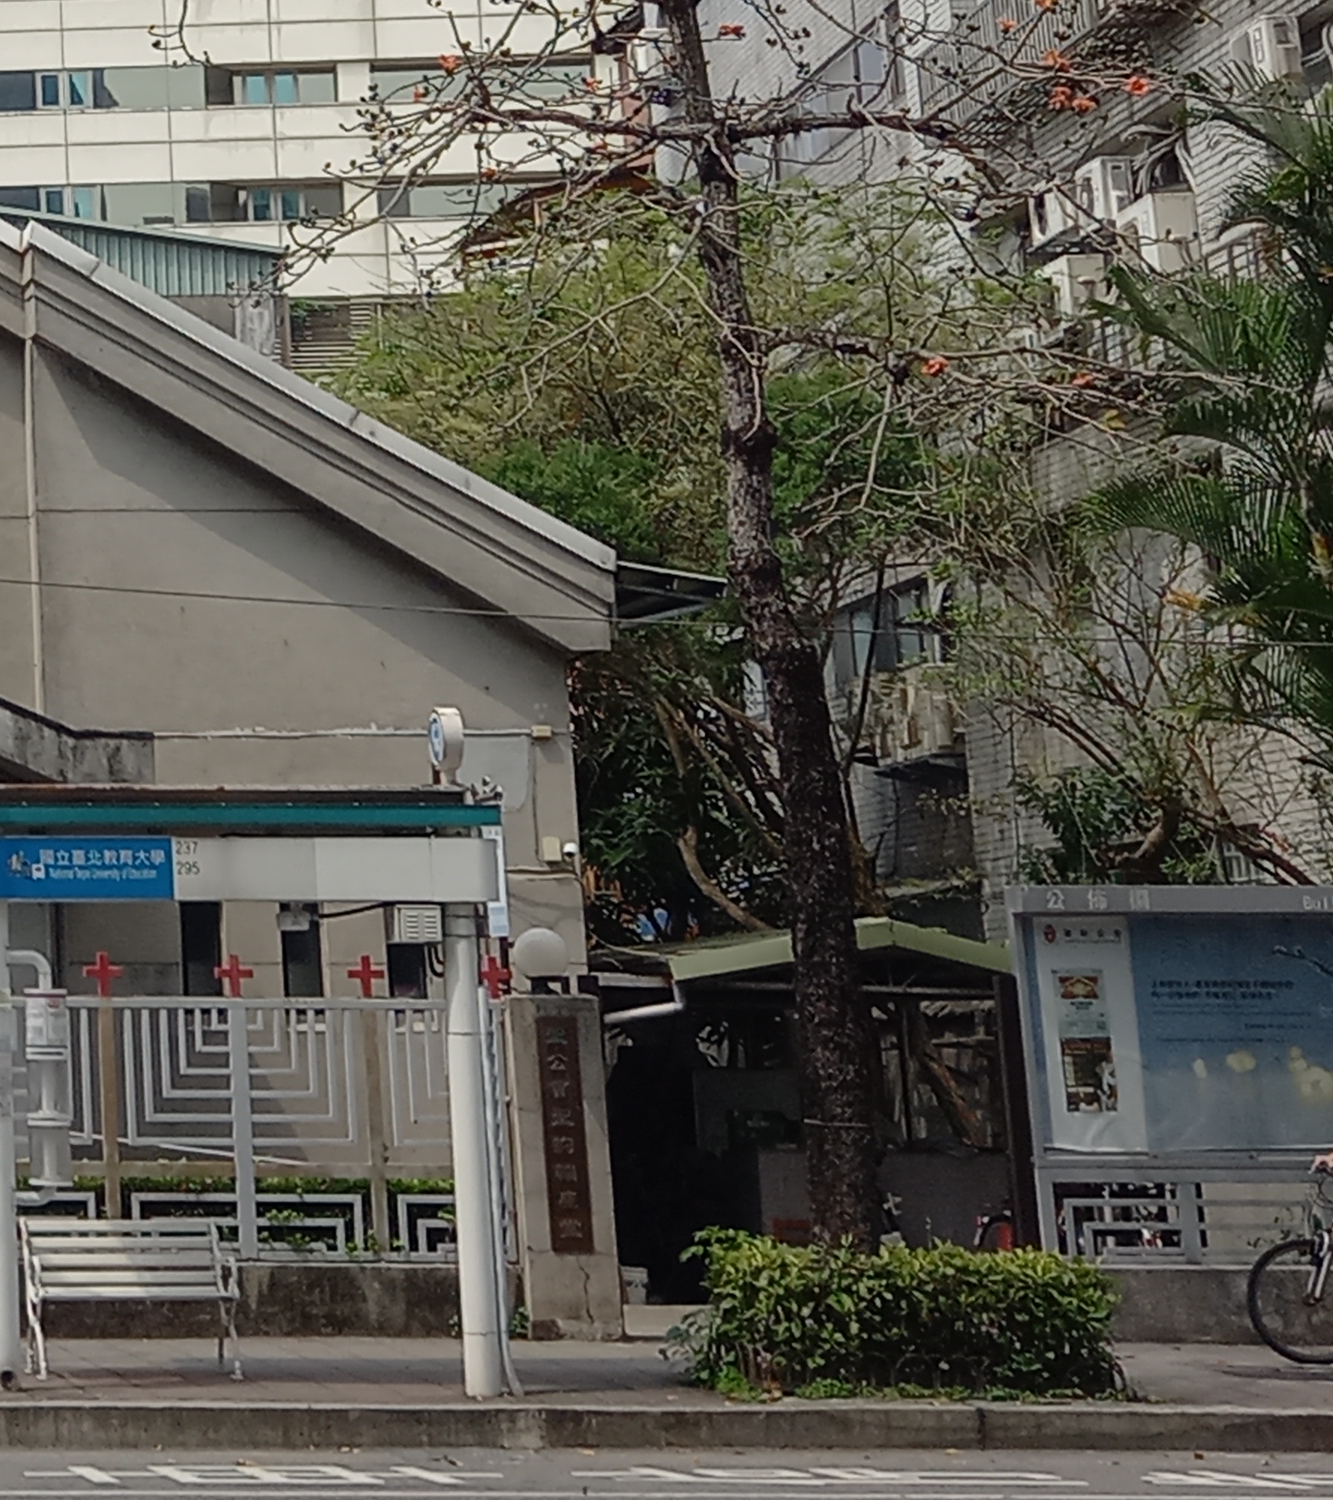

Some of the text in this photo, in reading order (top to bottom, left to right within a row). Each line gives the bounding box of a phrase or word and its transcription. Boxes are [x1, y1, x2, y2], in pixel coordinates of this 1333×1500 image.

[175, 841, 198, 855] 237
[176, 861, 201, 875] 295
[1302, 895, 1333, 910] Bul
